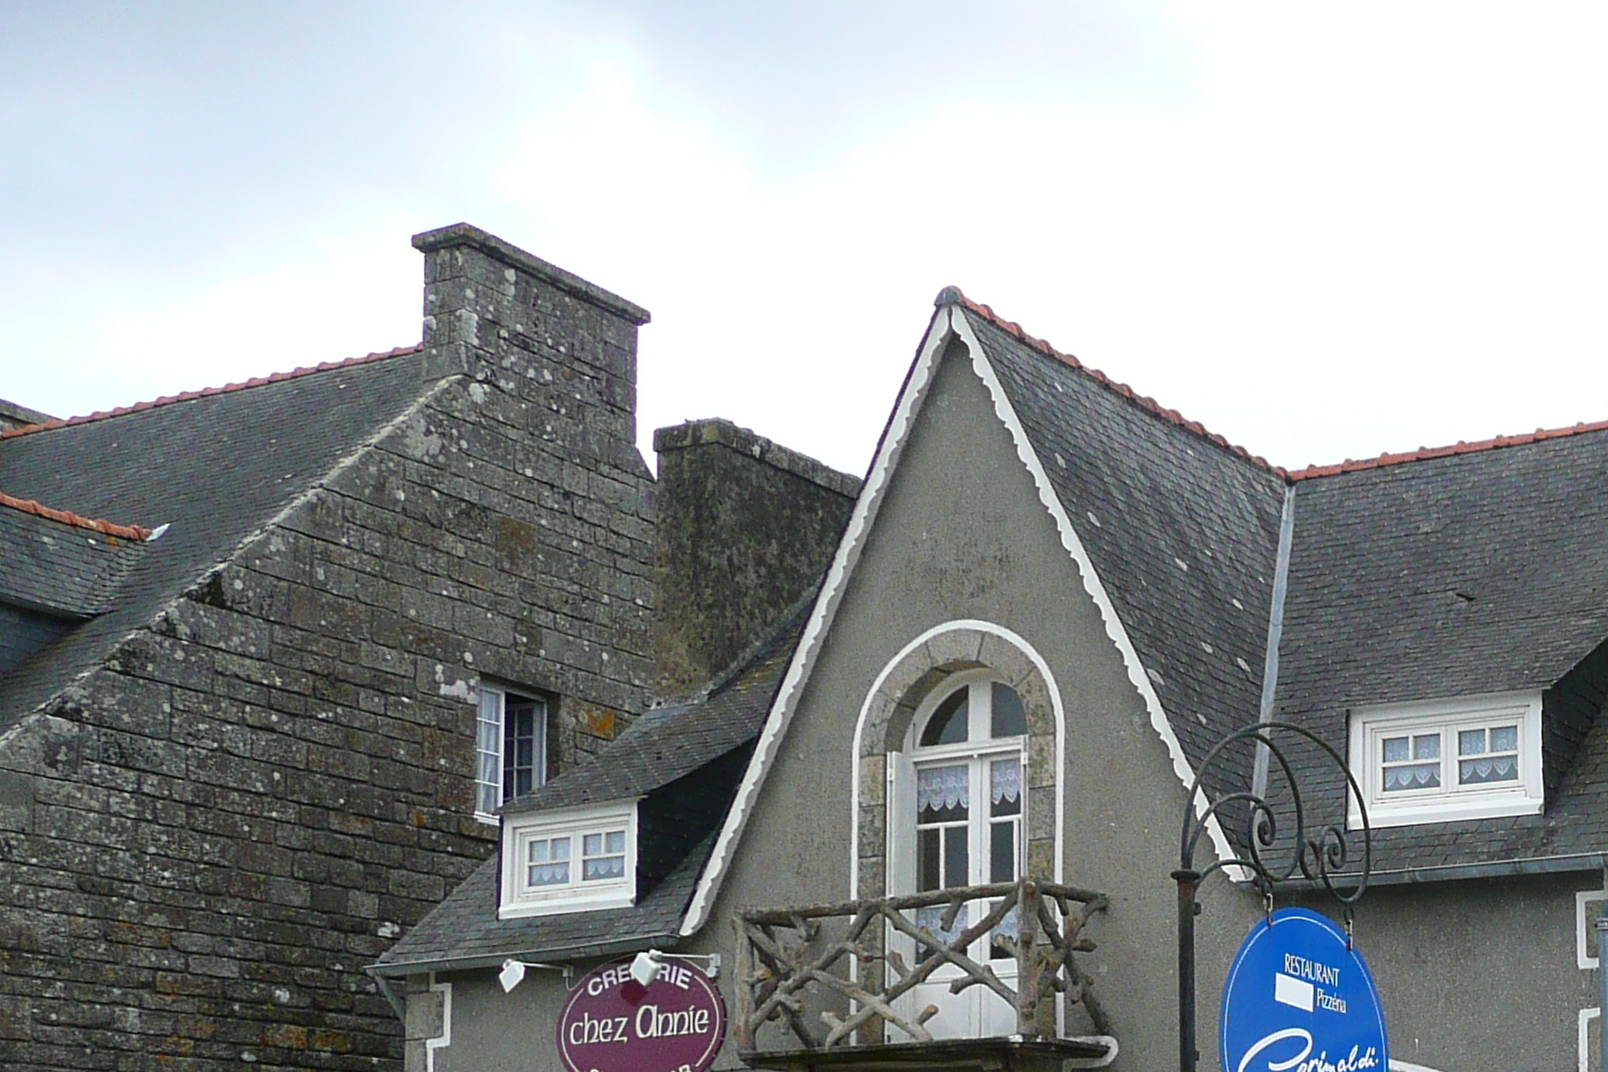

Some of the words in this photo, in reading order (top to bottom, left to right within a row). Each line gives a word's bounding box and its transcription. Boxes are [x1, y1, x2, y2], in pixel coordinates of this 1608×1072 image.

[587, 962, 692, 996] CRERIE
[1284, 953, 1340, 988] RESTAURANT
[1316, 987, 1347, 1014] Pizzéria
[569, 1012, 629, 1045] chez
